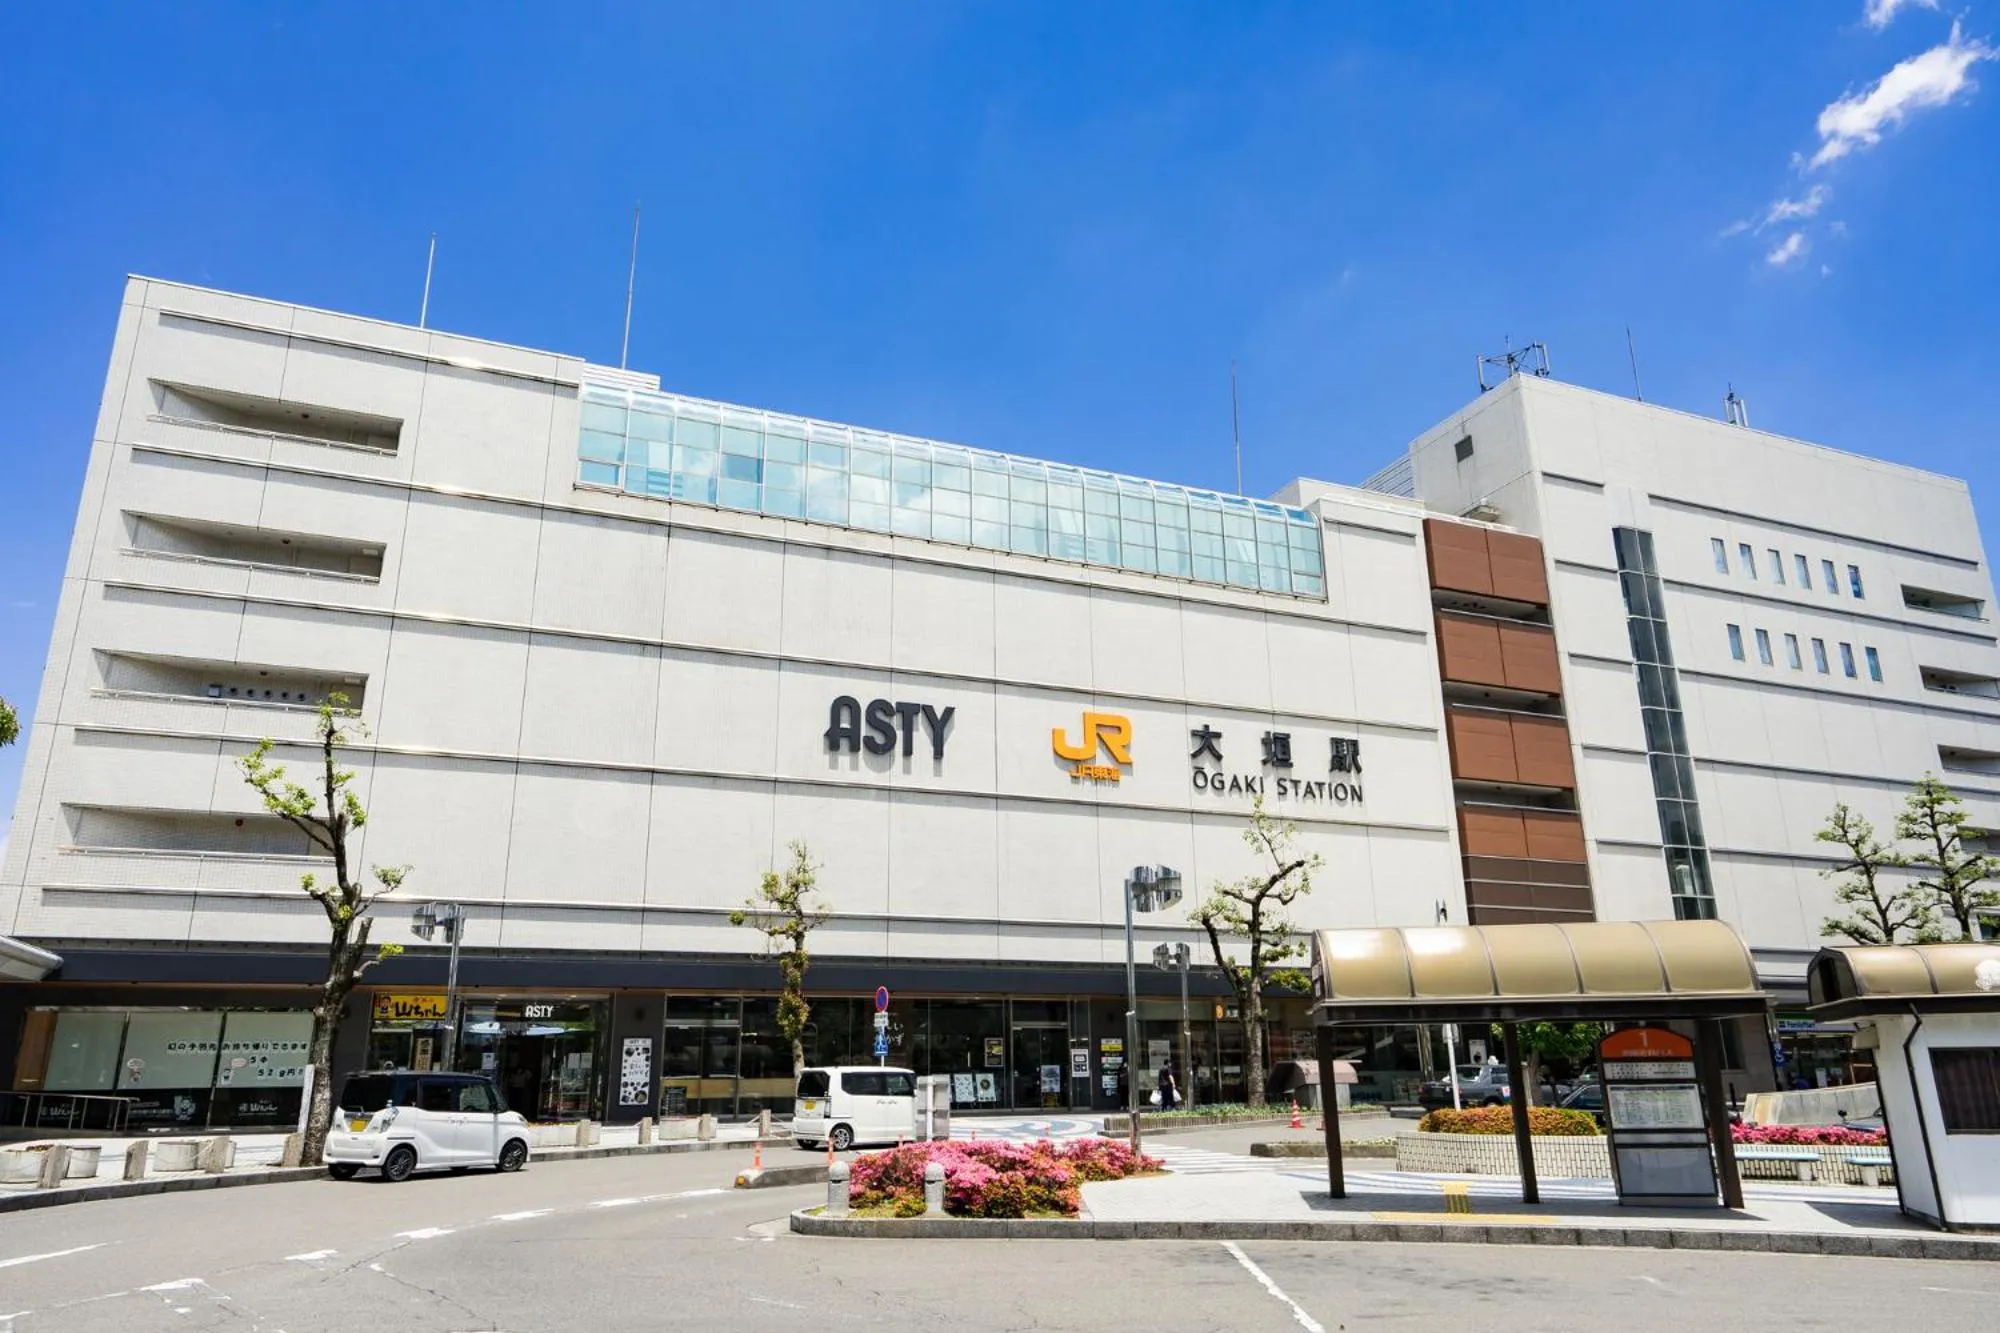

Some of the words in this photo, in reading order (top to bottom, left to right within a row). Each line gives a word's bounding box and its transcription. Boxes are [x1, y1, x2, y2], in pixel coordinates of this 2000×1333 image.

[823, 695, 956, 759] ASTY
[1052, 711, 1133, 765] JR
[1190, 724, 1362, 774] 大垣駅
[1070, 764, 1120, 782] JR東海
[1276, 777, 1364, 802] STATION
[525, 1005, 554, 1018] ASTY
